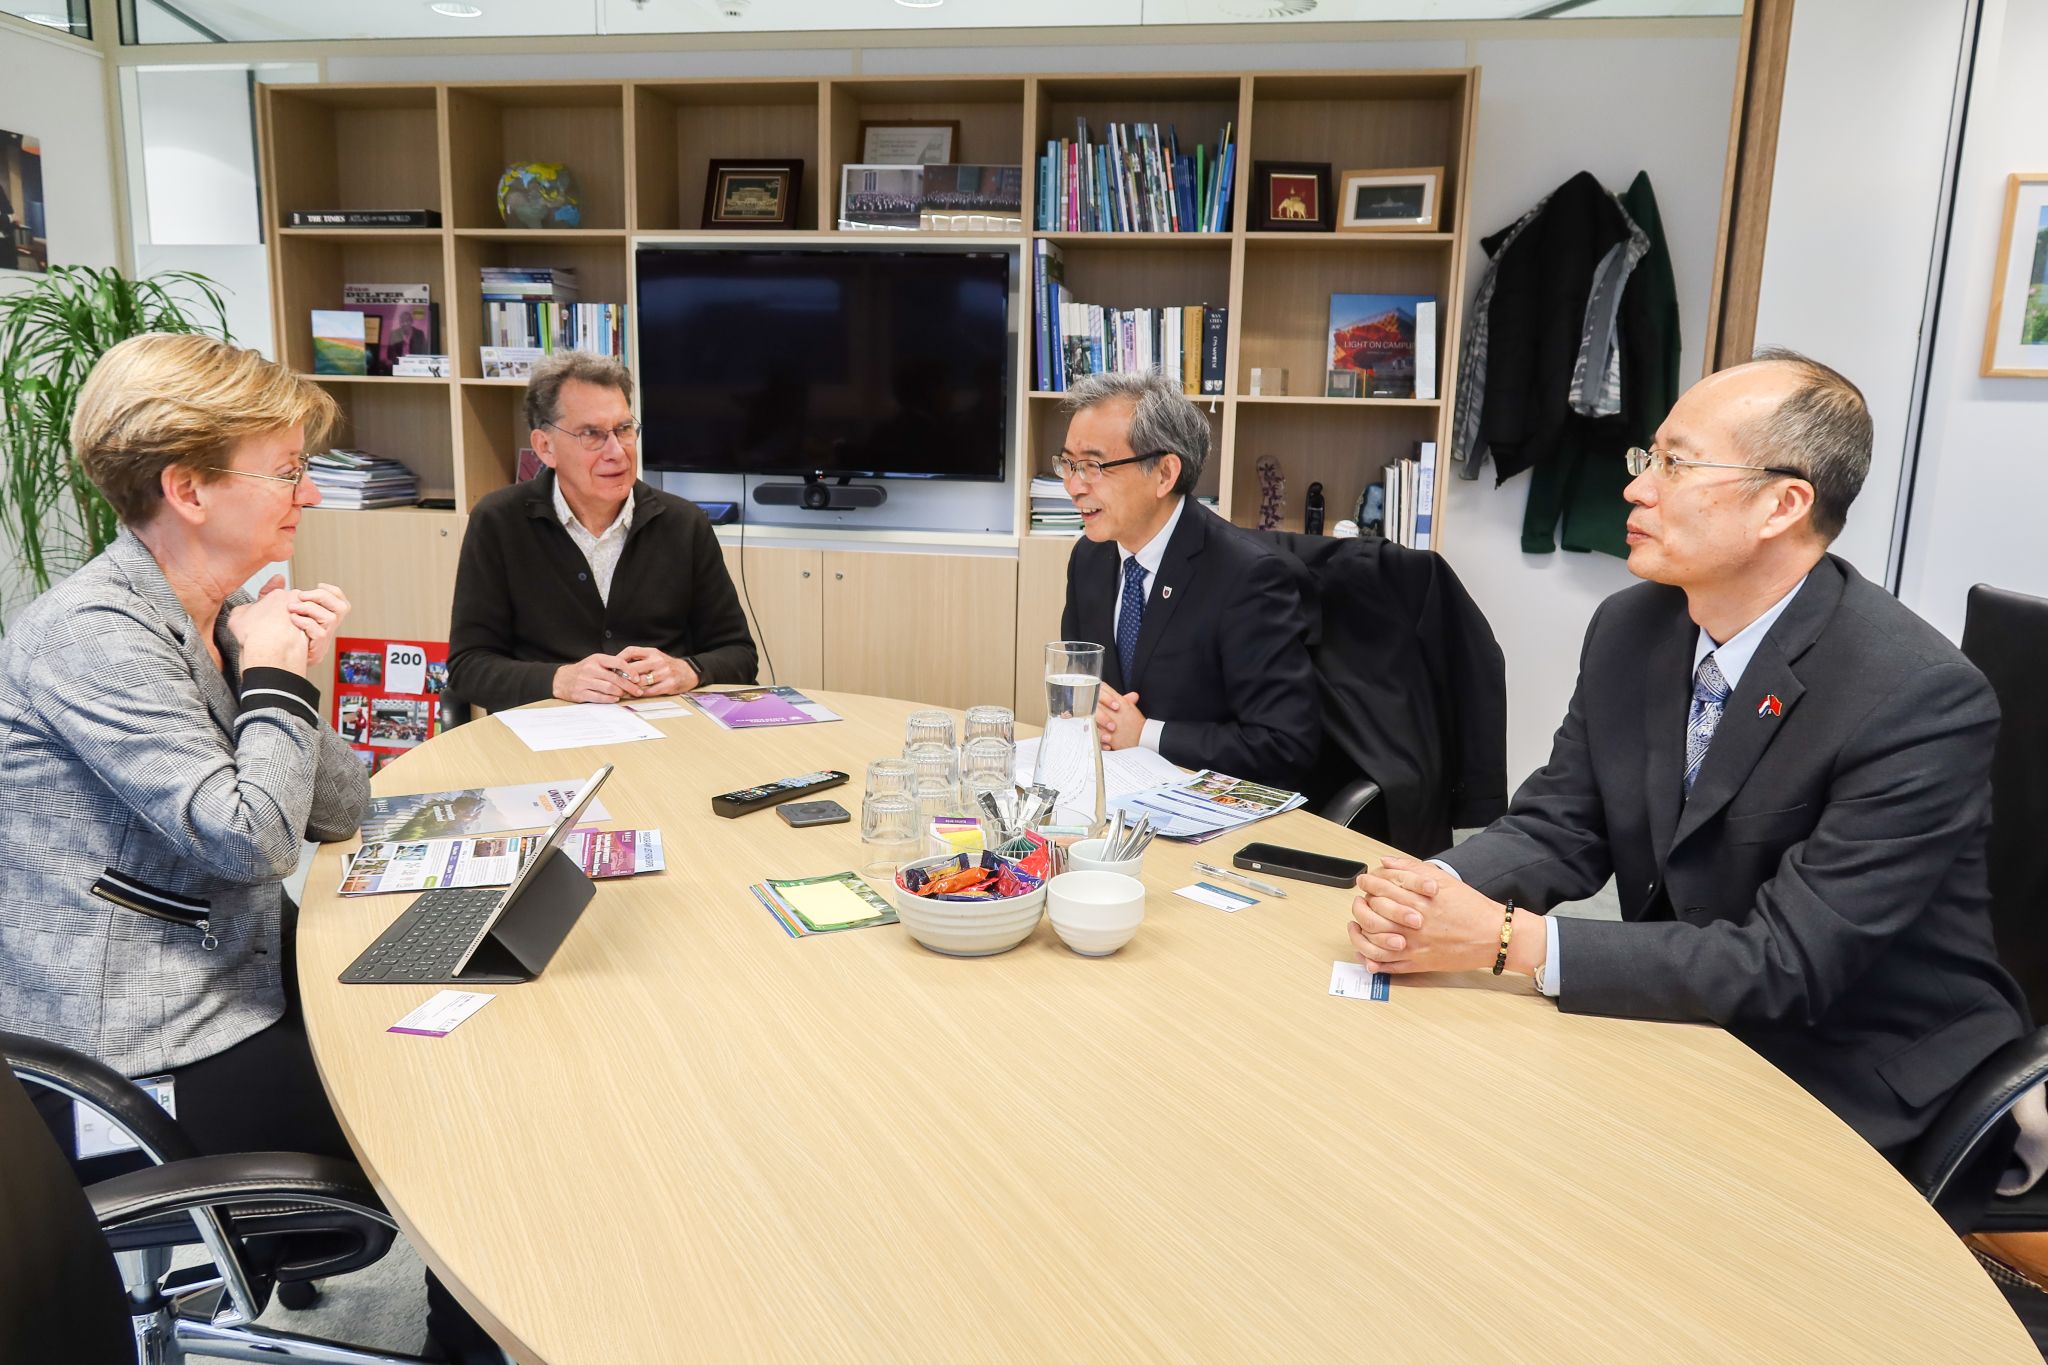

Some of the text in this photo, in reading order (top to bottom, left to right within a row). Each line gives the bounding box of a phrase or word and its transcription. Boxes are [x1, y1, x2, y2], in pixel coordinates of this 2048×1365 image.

[307, 214, 321, 223] THE
[323, 214, 346, 223] TIMES
[1344, 340, 1367, 349] LIGHT
[1369, 340, 1381, 349] ON
[390, 652, 422, 666] 200
